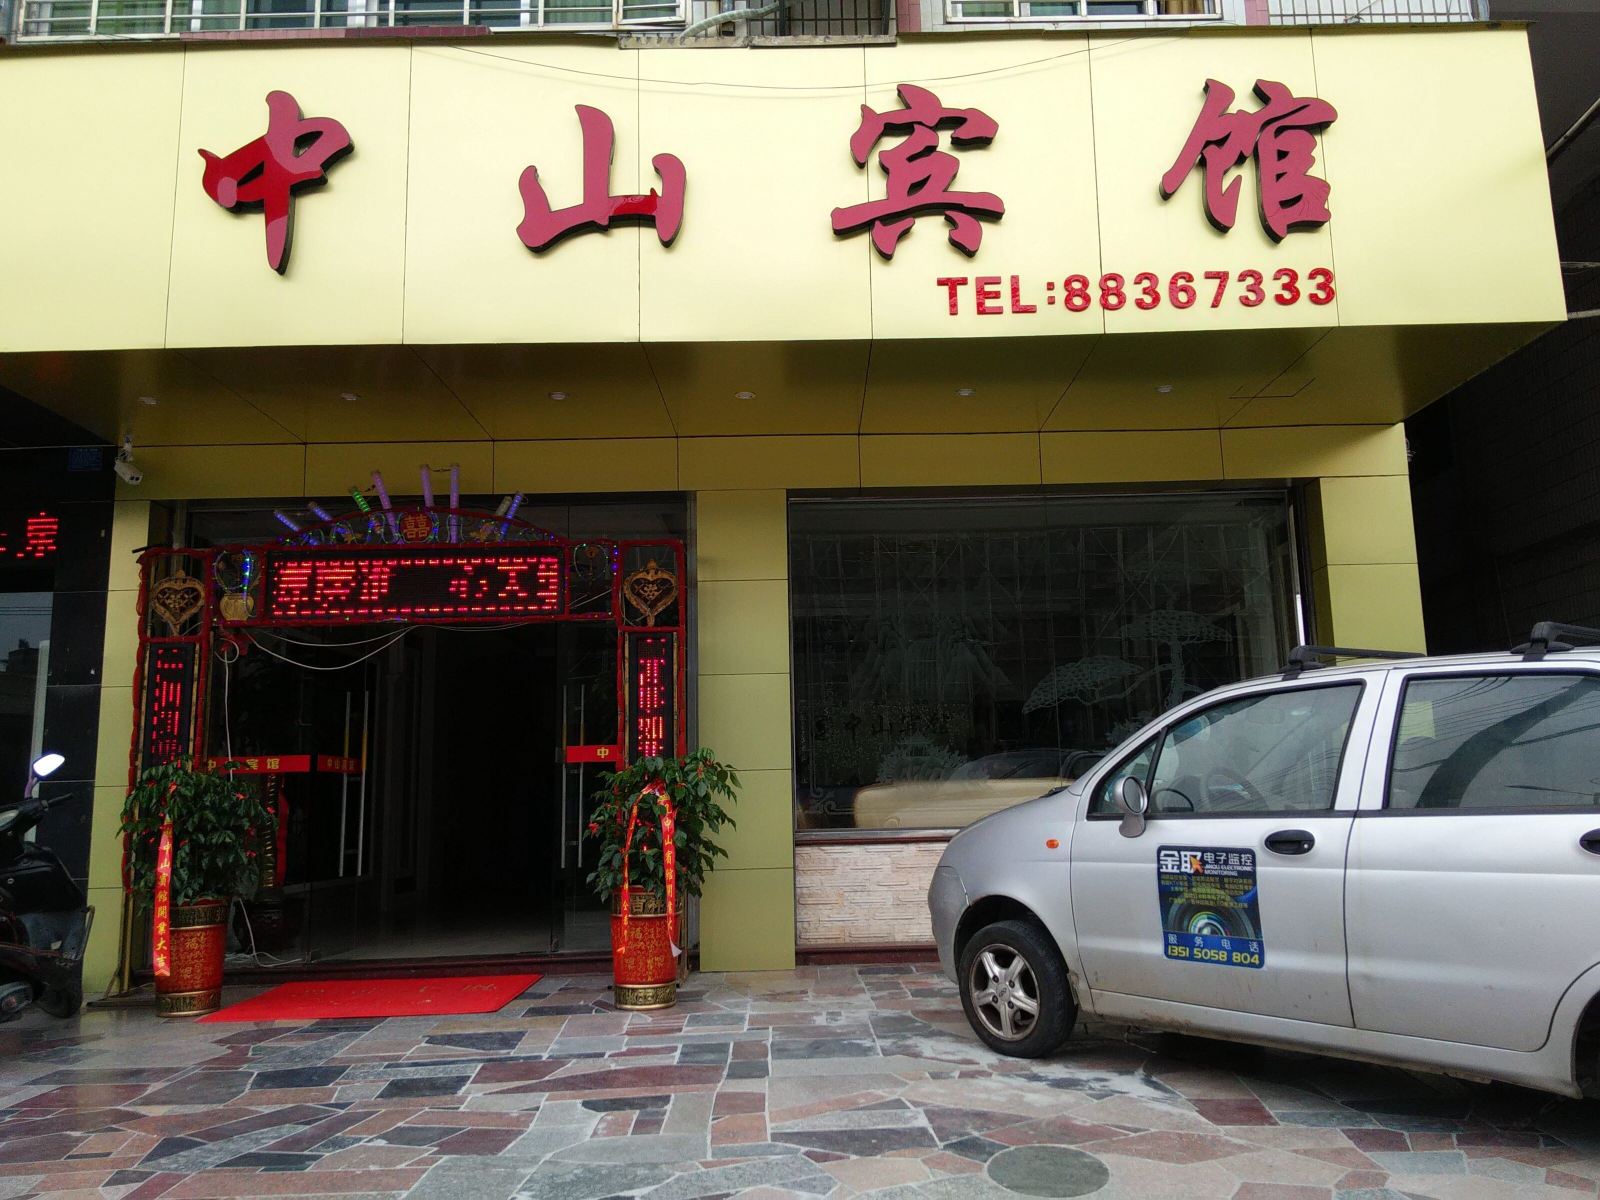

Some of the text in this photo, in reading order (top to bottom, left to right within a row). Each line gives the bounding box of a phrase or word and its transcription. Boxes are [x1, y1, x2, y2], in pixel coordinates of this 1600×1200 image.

[198, 78, 1338, 275] 中山宾馆
[936, 267, 1336, 316] TEL:88367333
[596, 746, 610, 759] 中
[207, 757, 281, 771] 中宾馆
[1203, 852, 1253, 865] 电子监控
[1168, 933, 1260, 953] 服务电话
[1168, 945, 1260, 965] 1351 5058 804
